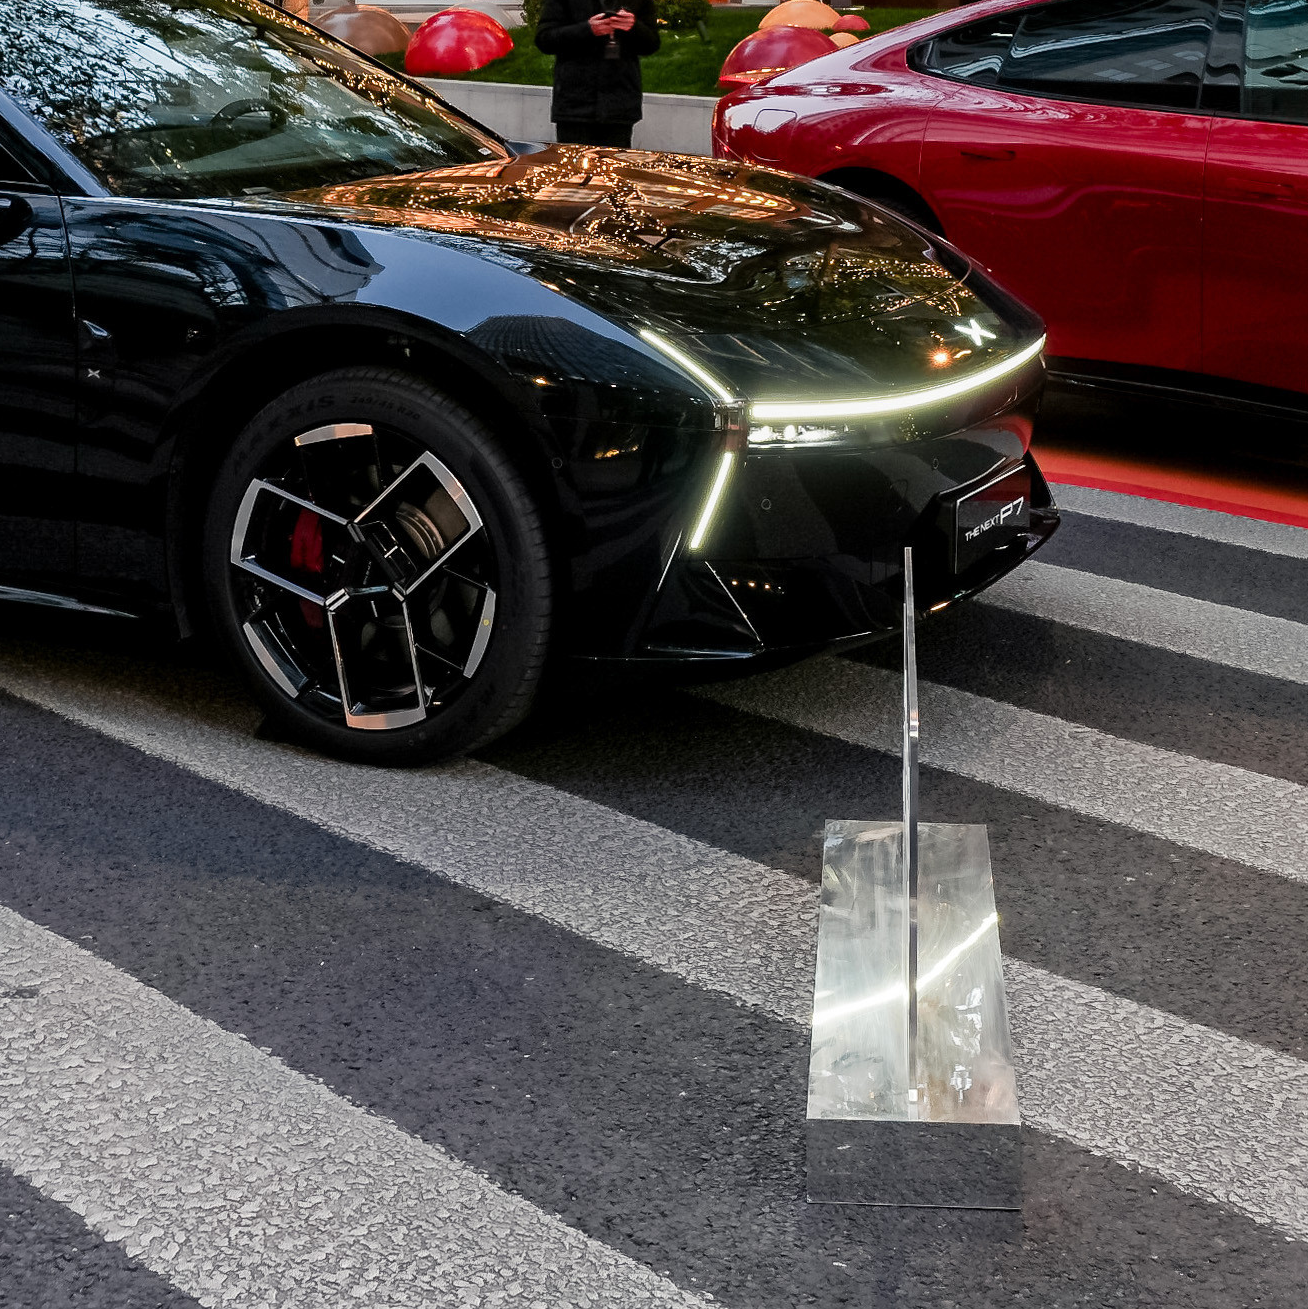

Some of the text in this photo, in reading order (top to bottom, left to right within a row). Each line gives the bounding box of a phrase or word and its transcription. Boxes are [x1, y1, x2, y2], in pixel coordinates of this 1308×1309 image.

[965, 496, 1024, 542] THE NEXT P7
